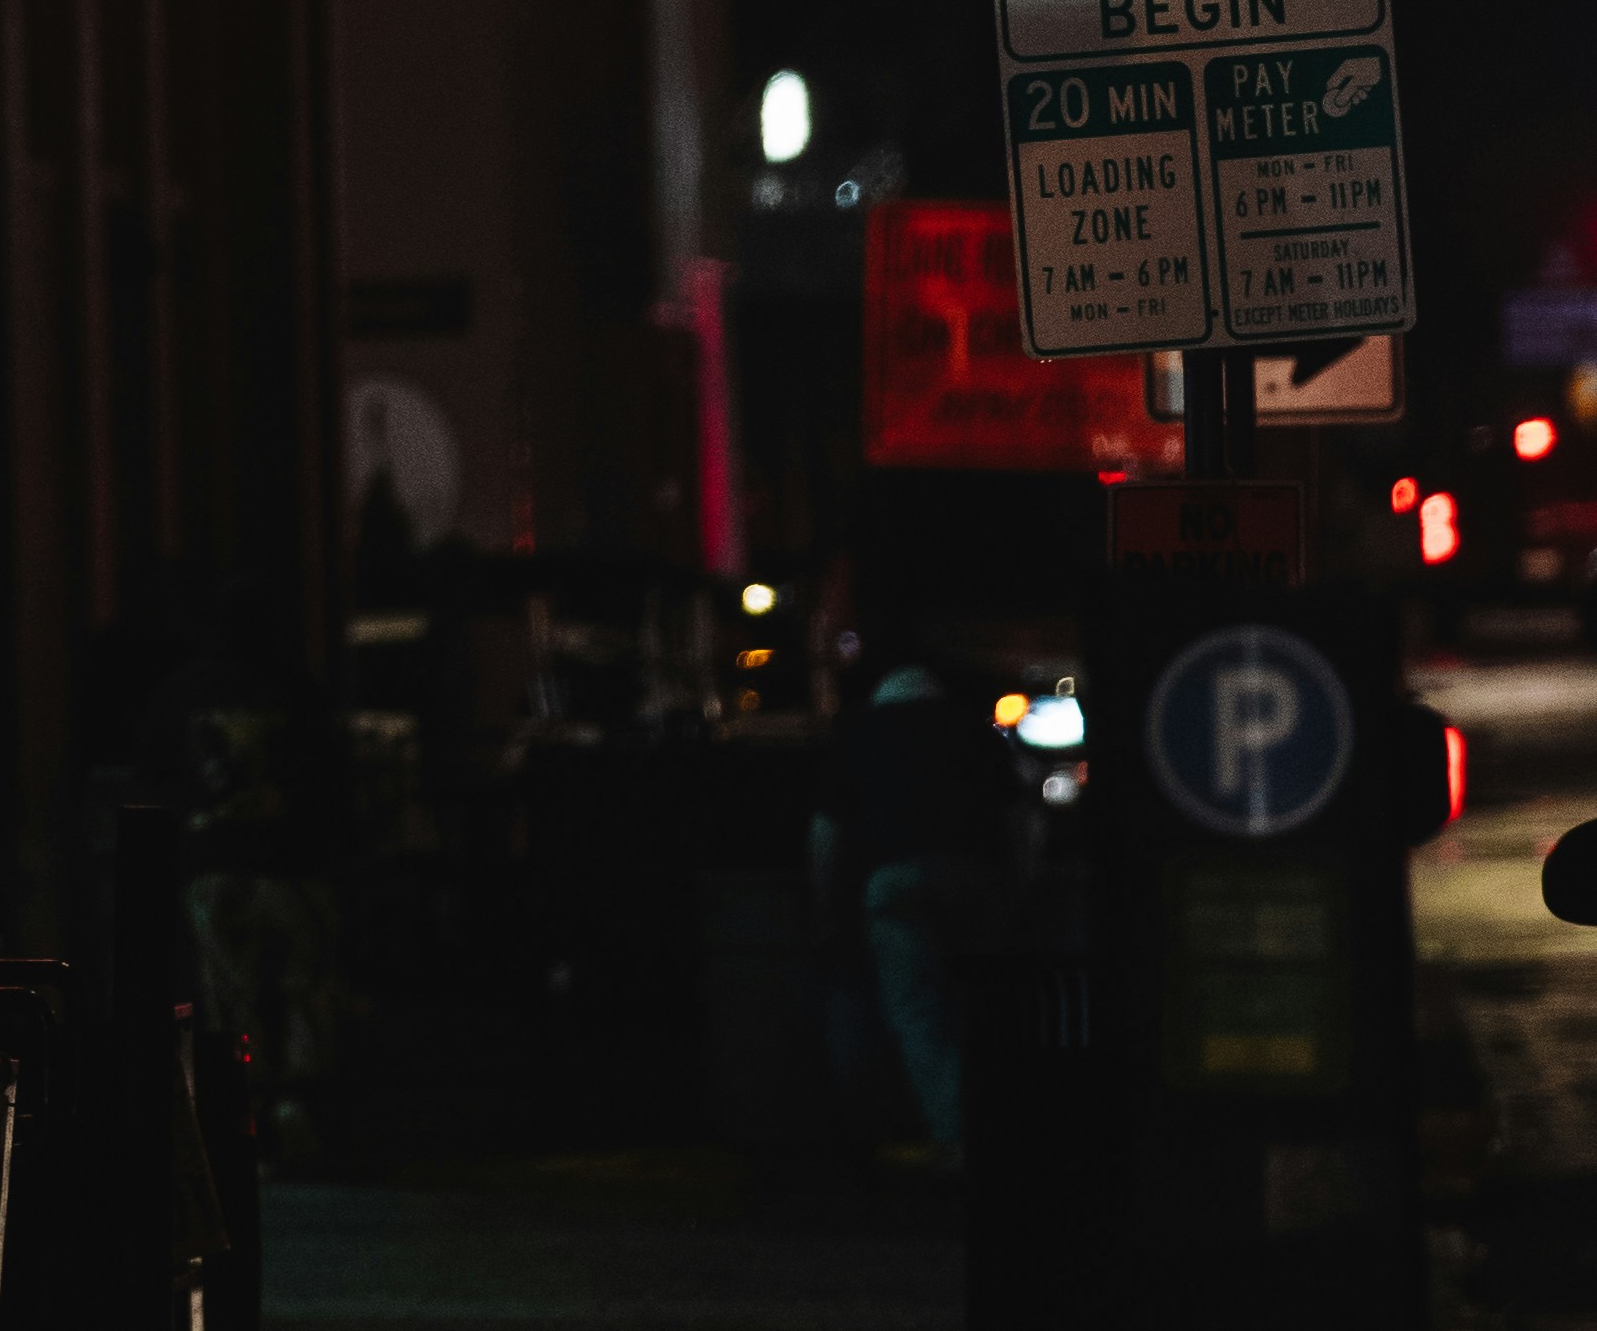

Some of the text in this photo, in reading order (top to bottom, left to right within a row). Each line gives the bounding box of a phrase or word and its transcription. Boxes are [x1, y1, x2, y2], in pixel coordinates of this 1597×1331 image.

[1233, 59, 1293, 98] PAY
[1025, 78, 1178, 130] 20 MIN
[1216, 101, 1320, 142] METER
[1038, 154, 1175, 198] LOADING
[1257, 159, 1295, 178] MON
[1324, 154, 1354, 172] FRI
[1235, 190, 1247, 217] 6
[1257, 187, 1287, 215] PM
[1071, 205, 1152, 245] ZONE
[1273, 239, 1349, 262] SATURDAY
[1042, 267, 1053, 294] 7
[1066, 264, 1096, 293] AM
[1138, 259, 1150, 287] 6
[1158, 256, 1189, 285] PM
[1240, 269, 1252, 297] 7
[1264, 267, 1295, 296] AM
[1070, 303, 1108, 321] MON
[1138, 298, 1166, 316] FRI
[1235, 295, 1400, 326] EXCEPT METER HOLIDAYS
[1180, 502, 1231, 540] NO
